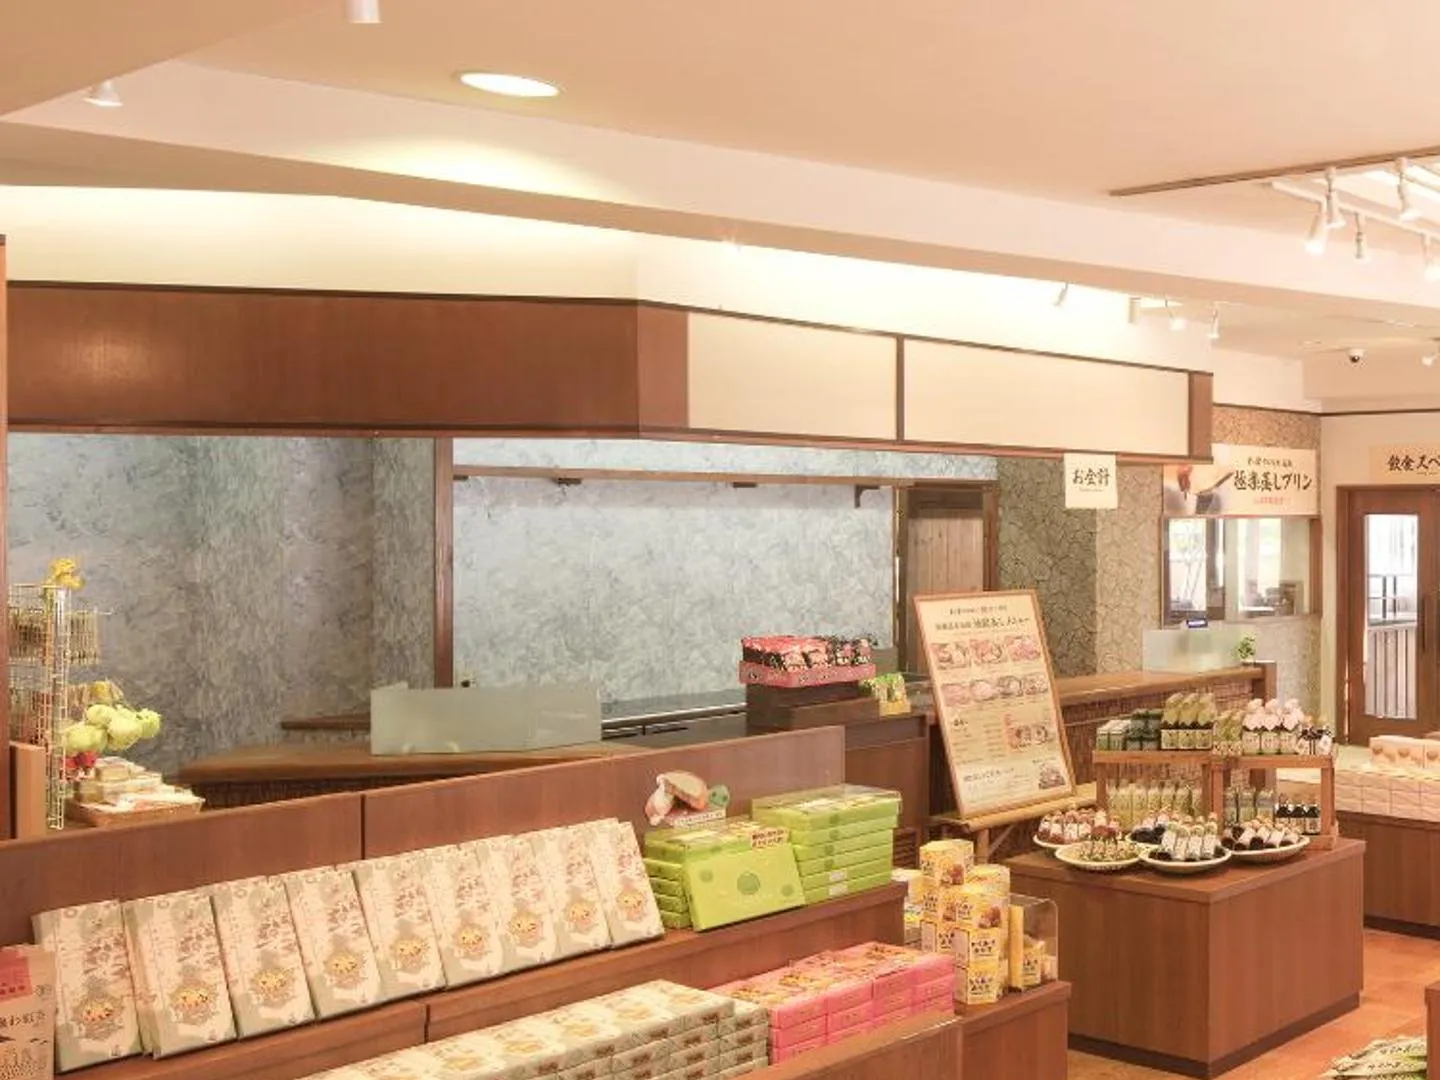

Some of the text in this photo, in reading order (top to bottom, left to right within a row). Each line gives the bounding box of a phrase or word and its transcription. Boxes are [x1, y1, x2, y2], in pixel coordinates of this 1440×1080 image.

[1072, 467, 1111, 487] お会計
[1234, 469, 1313, 492] 極楽蒸しプリン
